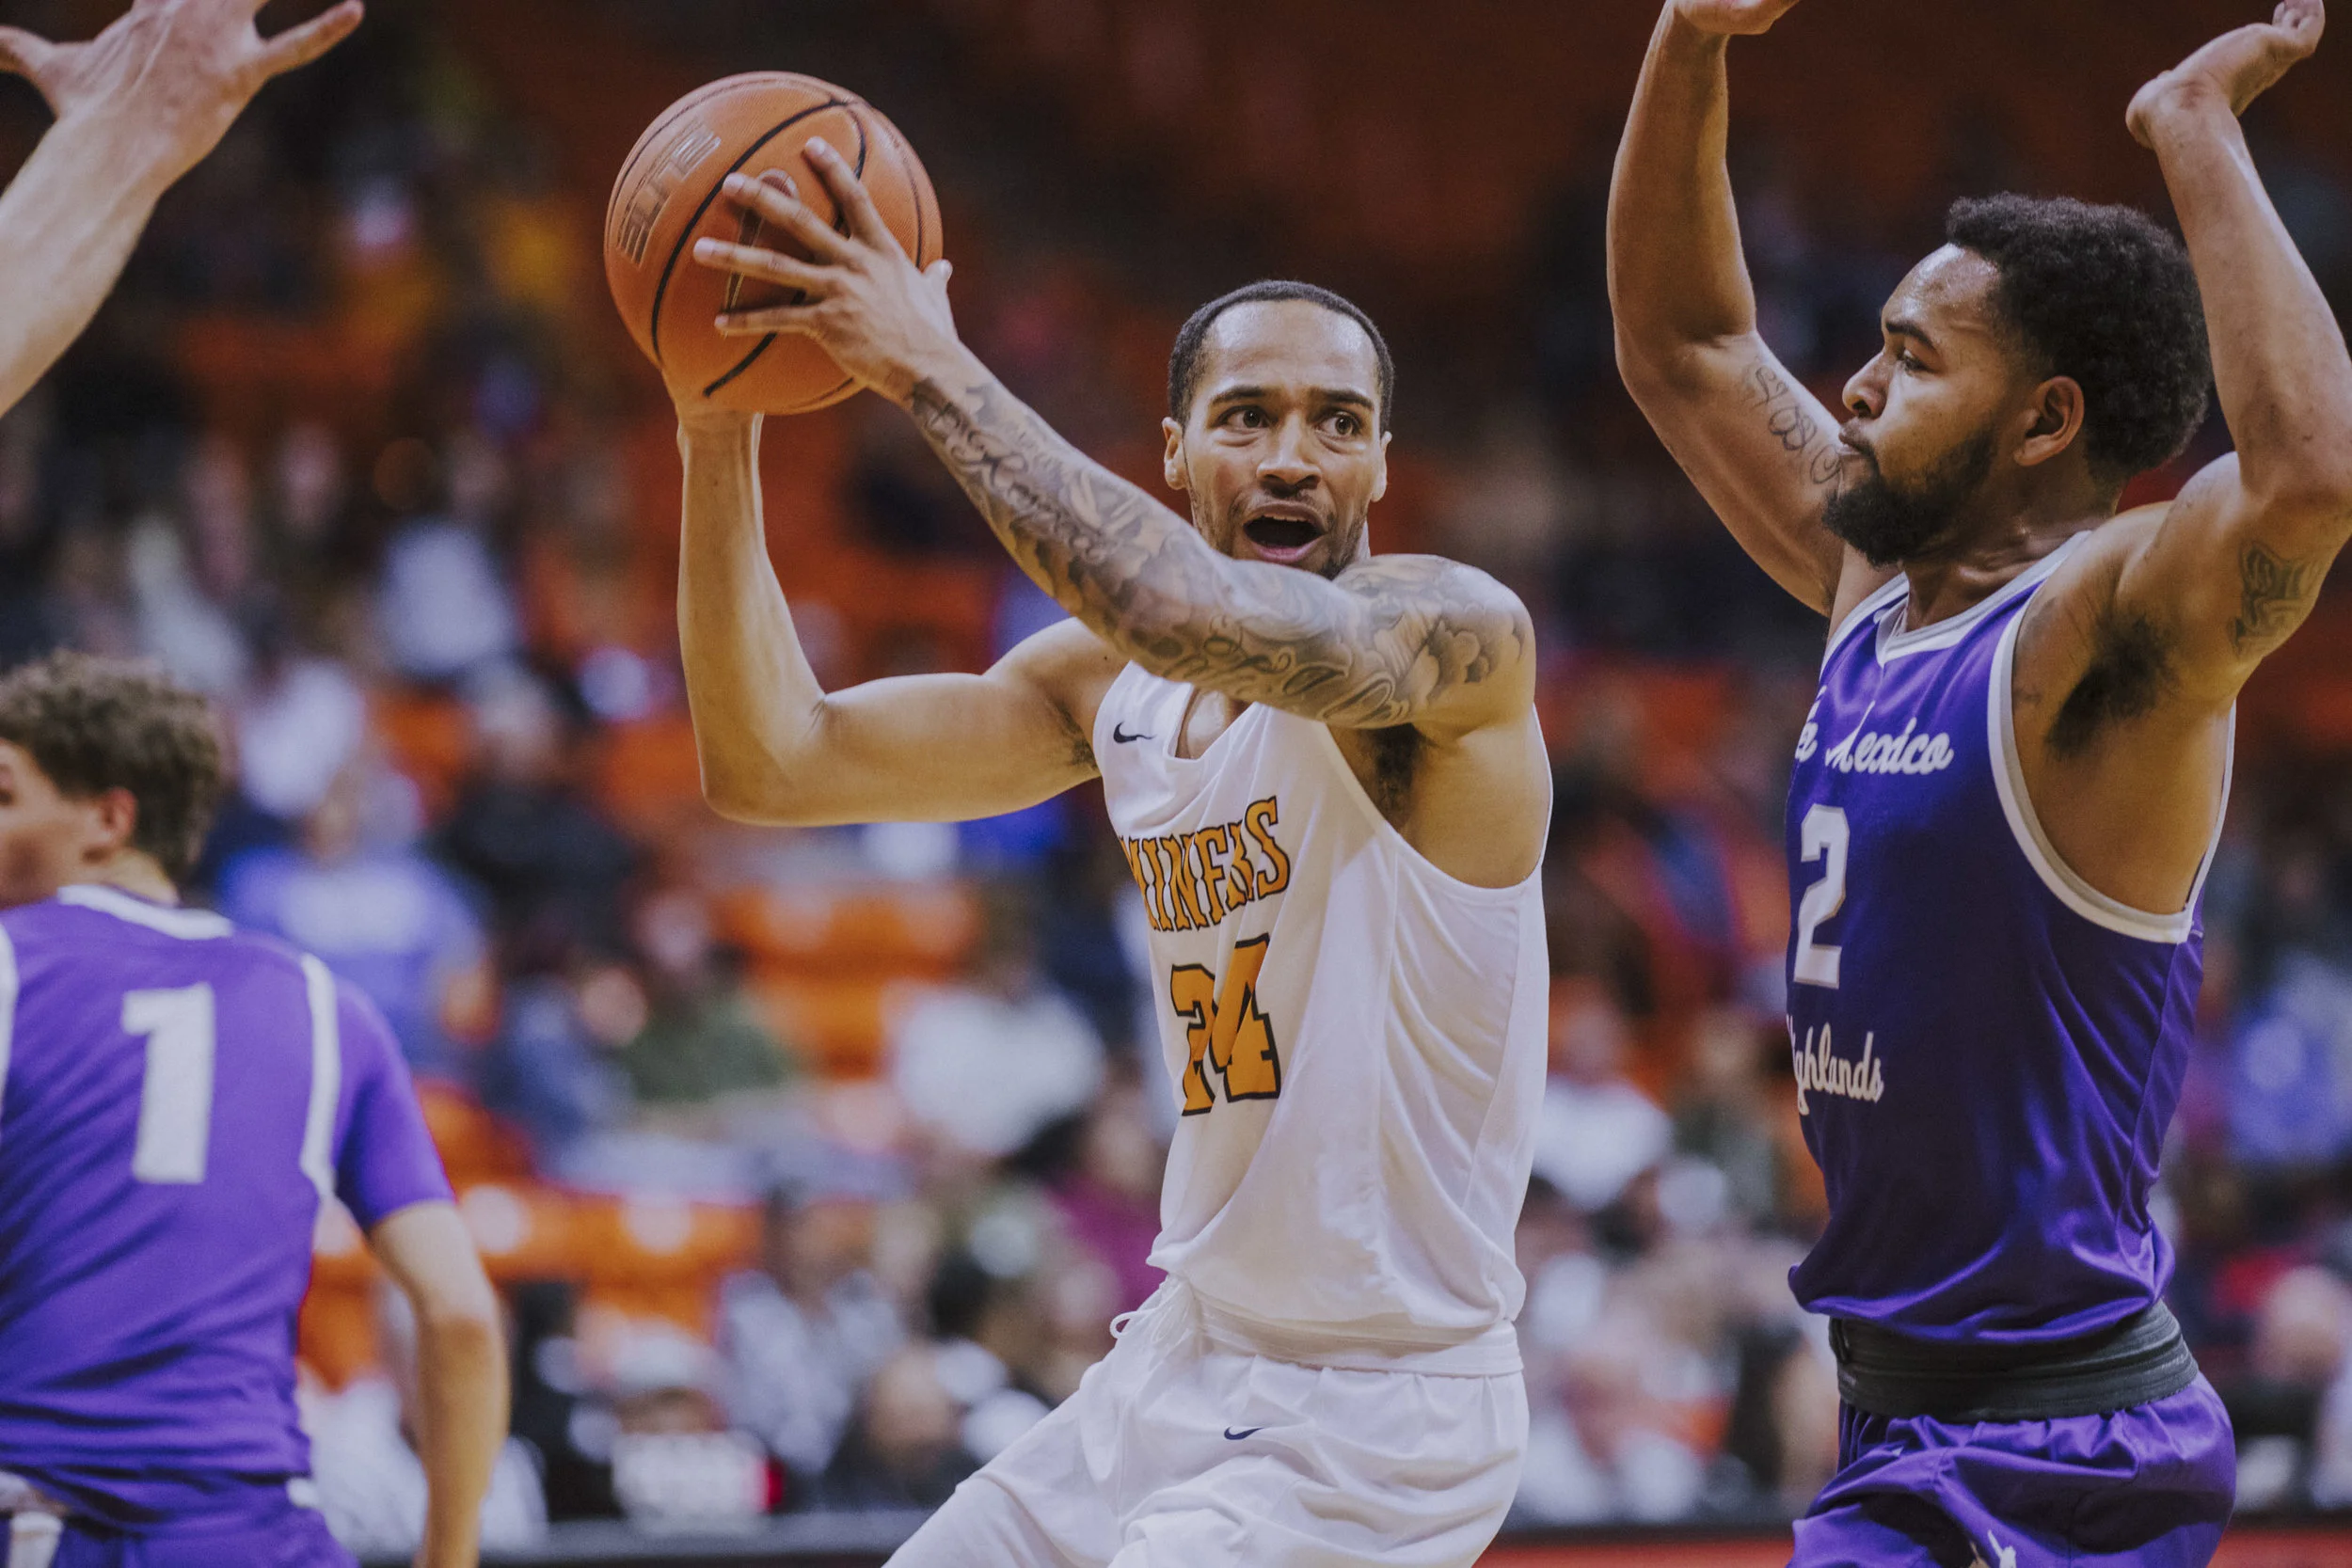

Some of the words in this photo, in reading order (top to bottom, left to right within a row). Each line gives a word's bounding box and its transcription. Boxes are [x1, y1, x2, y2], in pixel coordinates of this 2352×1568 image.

[1794, 803, 1850, 990] 2
[122, 981, 215, 1185] 1
[1170, 932, 1280, 1116] 24
